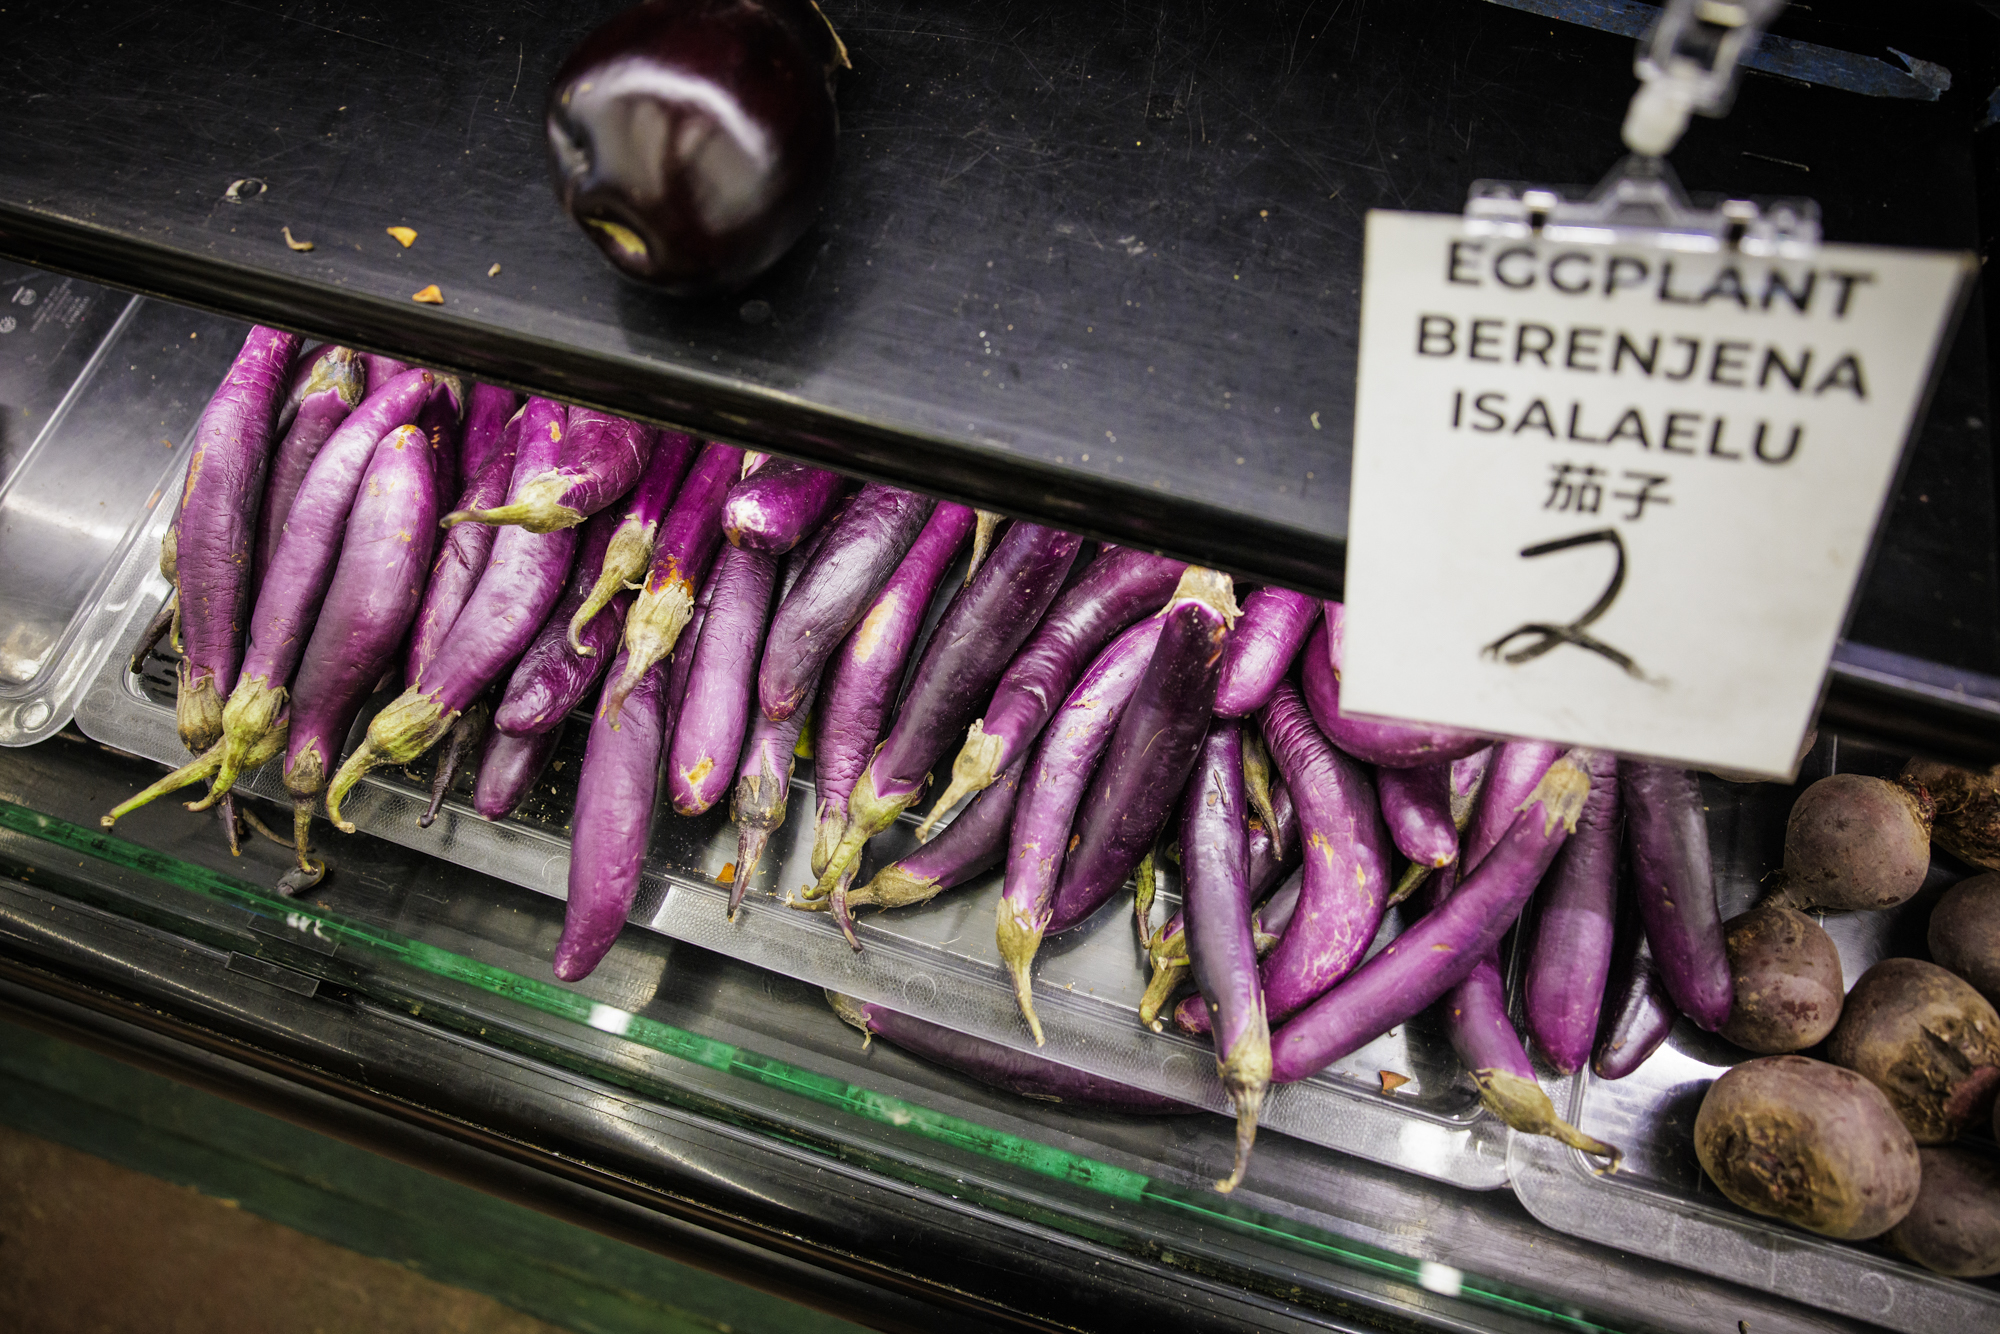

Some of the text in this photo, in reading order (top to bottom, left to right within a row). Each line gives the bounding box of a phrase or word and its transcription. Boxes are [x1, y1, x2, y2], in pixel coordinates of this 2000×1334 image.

[1446, 240, 1877, 320] EGGPLANT
[1415, 313, 1870, 402] BERENJENA
[1450, 389, 1806, 466] ISALAELU
[1541, 462, 1672, 522] 茄子
[1481, 527, 1668, 688] 2
